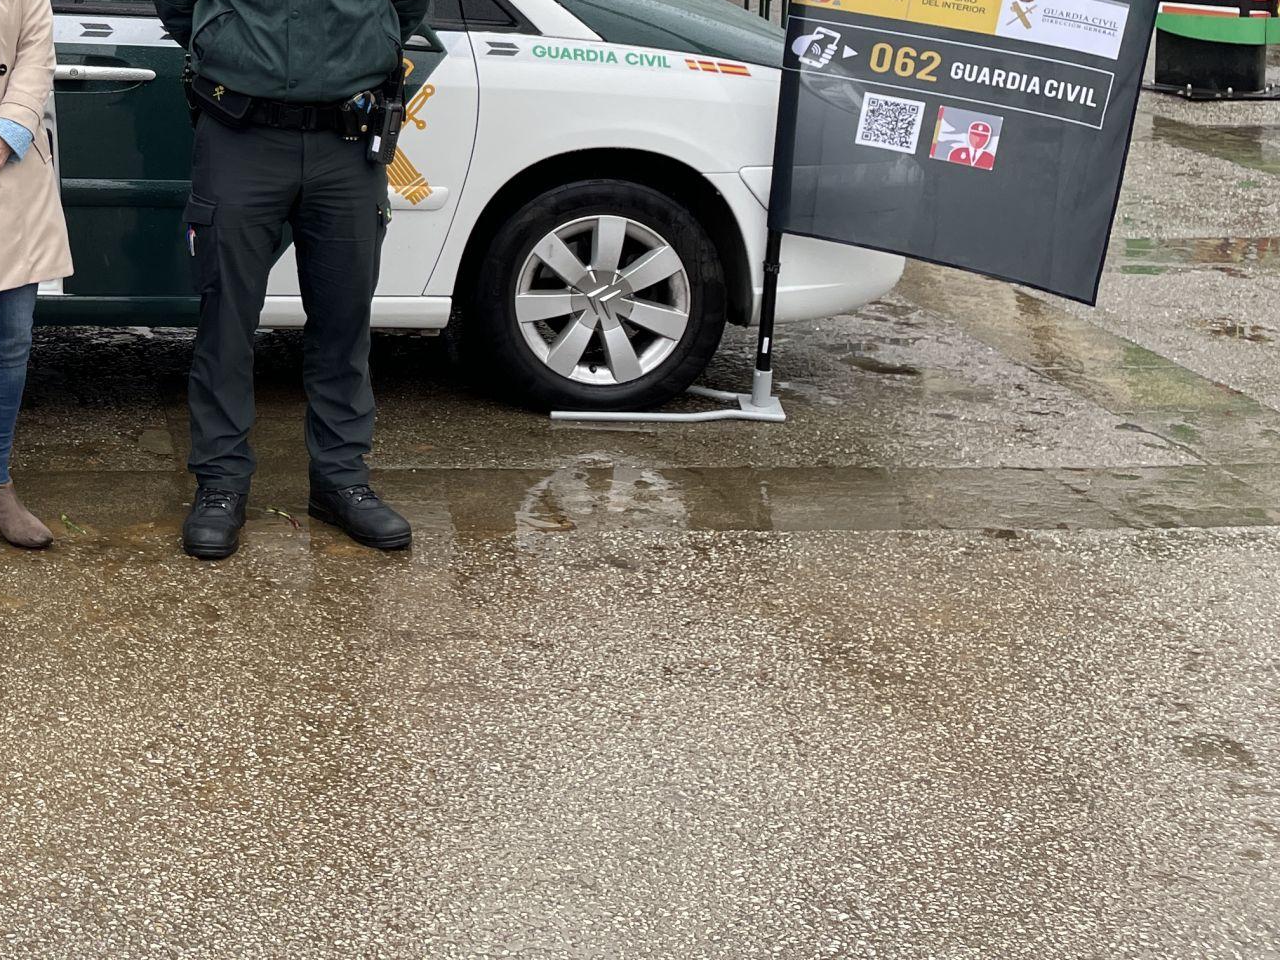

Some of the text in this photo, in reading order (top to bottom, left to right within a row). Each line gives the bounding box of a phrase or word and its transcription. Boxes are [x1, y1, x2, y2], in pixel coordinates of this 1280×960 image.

[941, 1, 986, 15] INTERIOR
[1043, 7, 1119, 29] GUARDIA CIVIL
[1083, 26, 1117, 37] GENERAL
[532, 45, 671, 68] GUARDIA CIVIL
[870, 43, 1097, 108] 062 GUARDIA CIVIL
